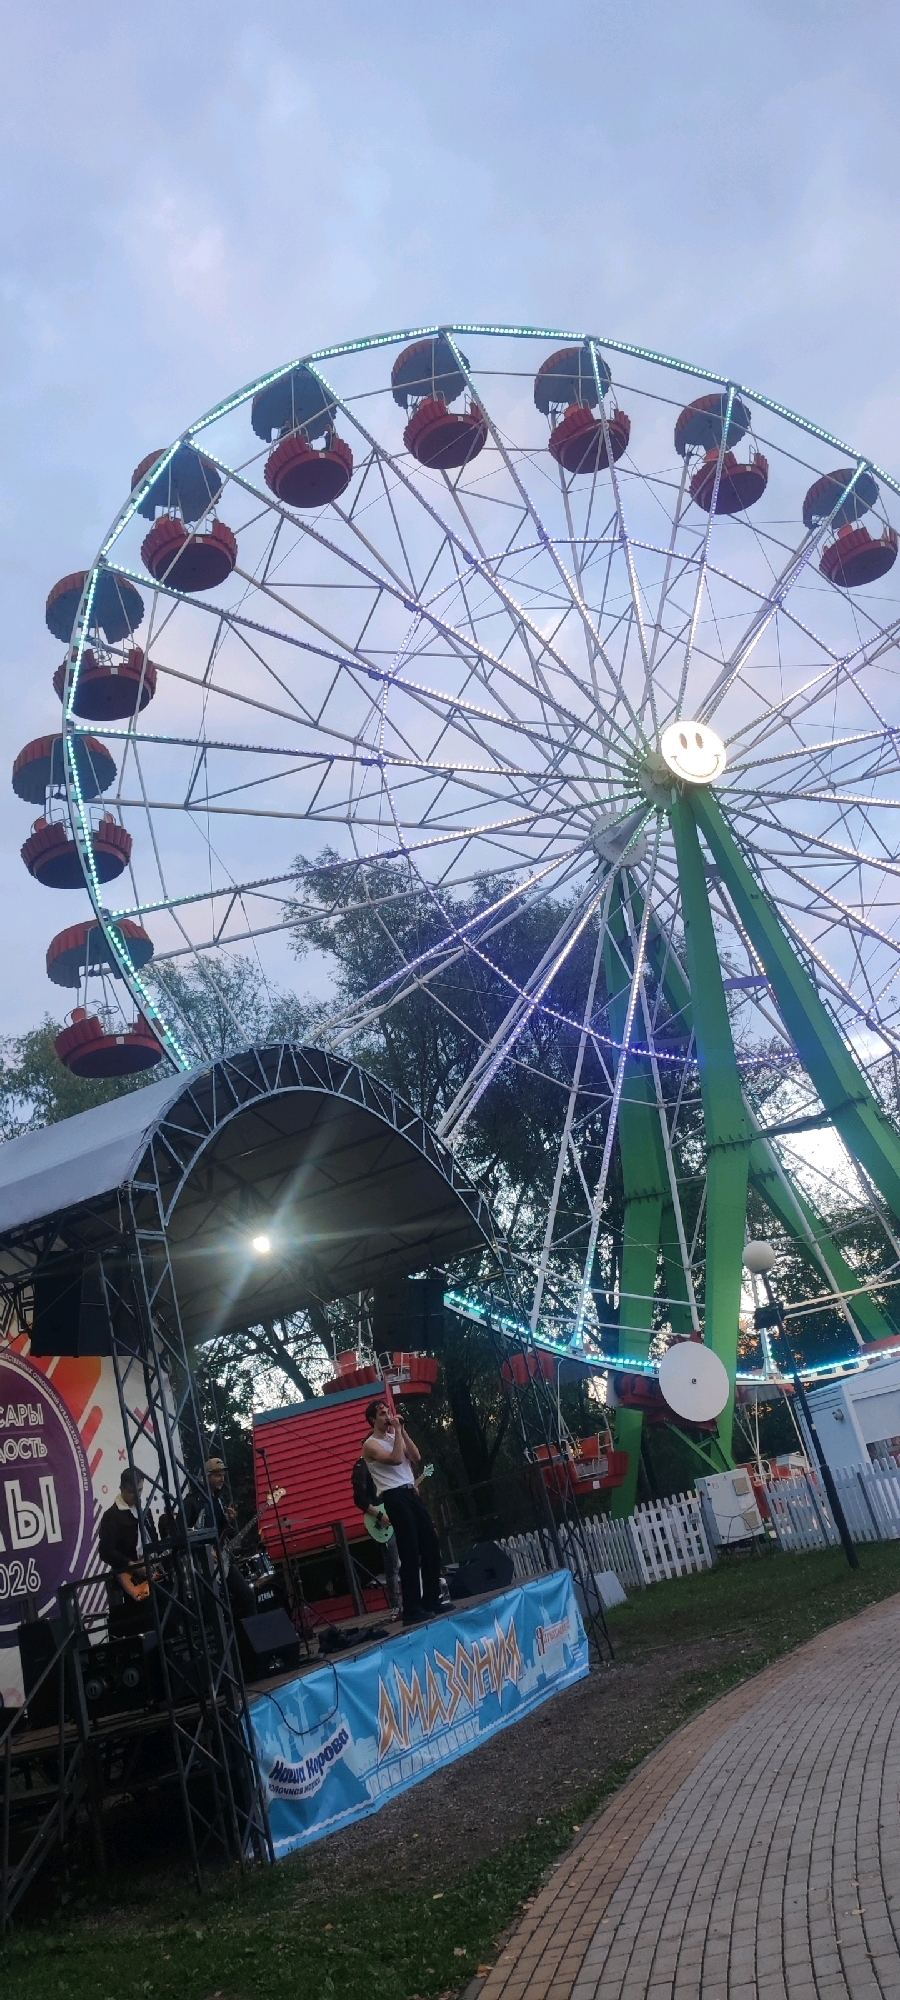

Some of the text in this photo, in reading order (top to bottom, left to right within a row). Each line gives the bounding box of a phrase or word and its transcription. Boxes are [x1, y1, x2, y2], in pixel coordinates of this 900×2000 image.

[58, 1402, 79, 1444] ЧУВАШСКОЙ
[76, 1444, 89, 1492] РЕСПУБЛИКИ
[0, 1475, 62, 1552] Ы
[377, 1613, 522, 1766] АМАЗОНИЯ
[269, 1728, 349, 1784] Наша Корова
